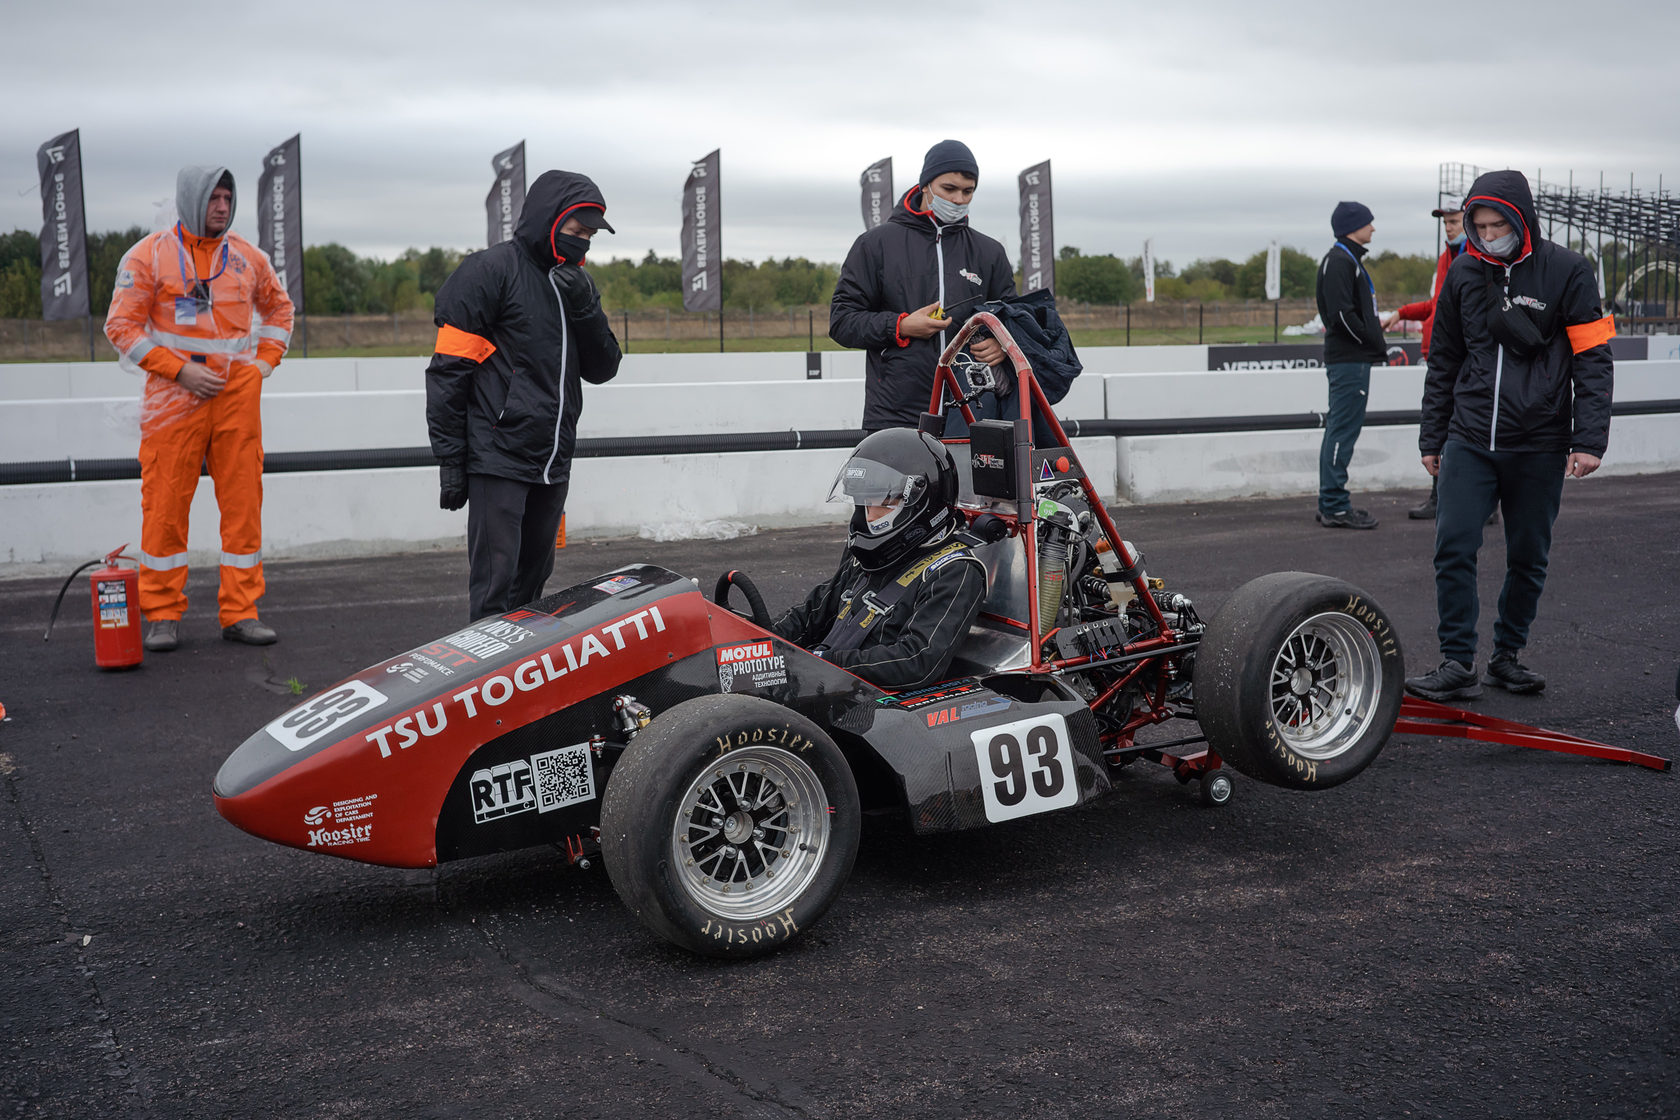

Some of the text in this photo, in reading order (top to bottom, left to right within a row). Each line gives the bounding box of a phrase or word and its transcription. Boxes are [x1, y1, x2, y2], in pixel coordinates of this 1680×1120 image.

[1341, 595, 1397, 657] Hoosier
[422, 644, 478, 667] STT
[720, 644, 770, 662] MOTUL
[733, 655, 785, 675] PROTOTYPE
[752, 669, 786, 681] АДДИТИВНЫЕ
[365, 606, 666, 759] TSU TOGLIATTI
[754, 677, 787, 688] ТЕХНОЛОГИИ
[283, 689, 370, 738] 93
[927, 707, 960, 727] VAL
[716, 723, 814, 758] Hoosier
[1265, 720, 1319, 782] Hoosier
[988, 725, 1064, 807] 93
[333, 793, 378, 807] DESIGNING AND
[472, 768, 531, 811] RTF
[334, 801, 372, 812] EXPLOITATION
[336, 812, 374, 823] DEPARTAMENT
[307, 823, 372, 846] Hoosier
[328, 838, 354, 847] RACING
[701, 907, 800, 950] Hoosier
